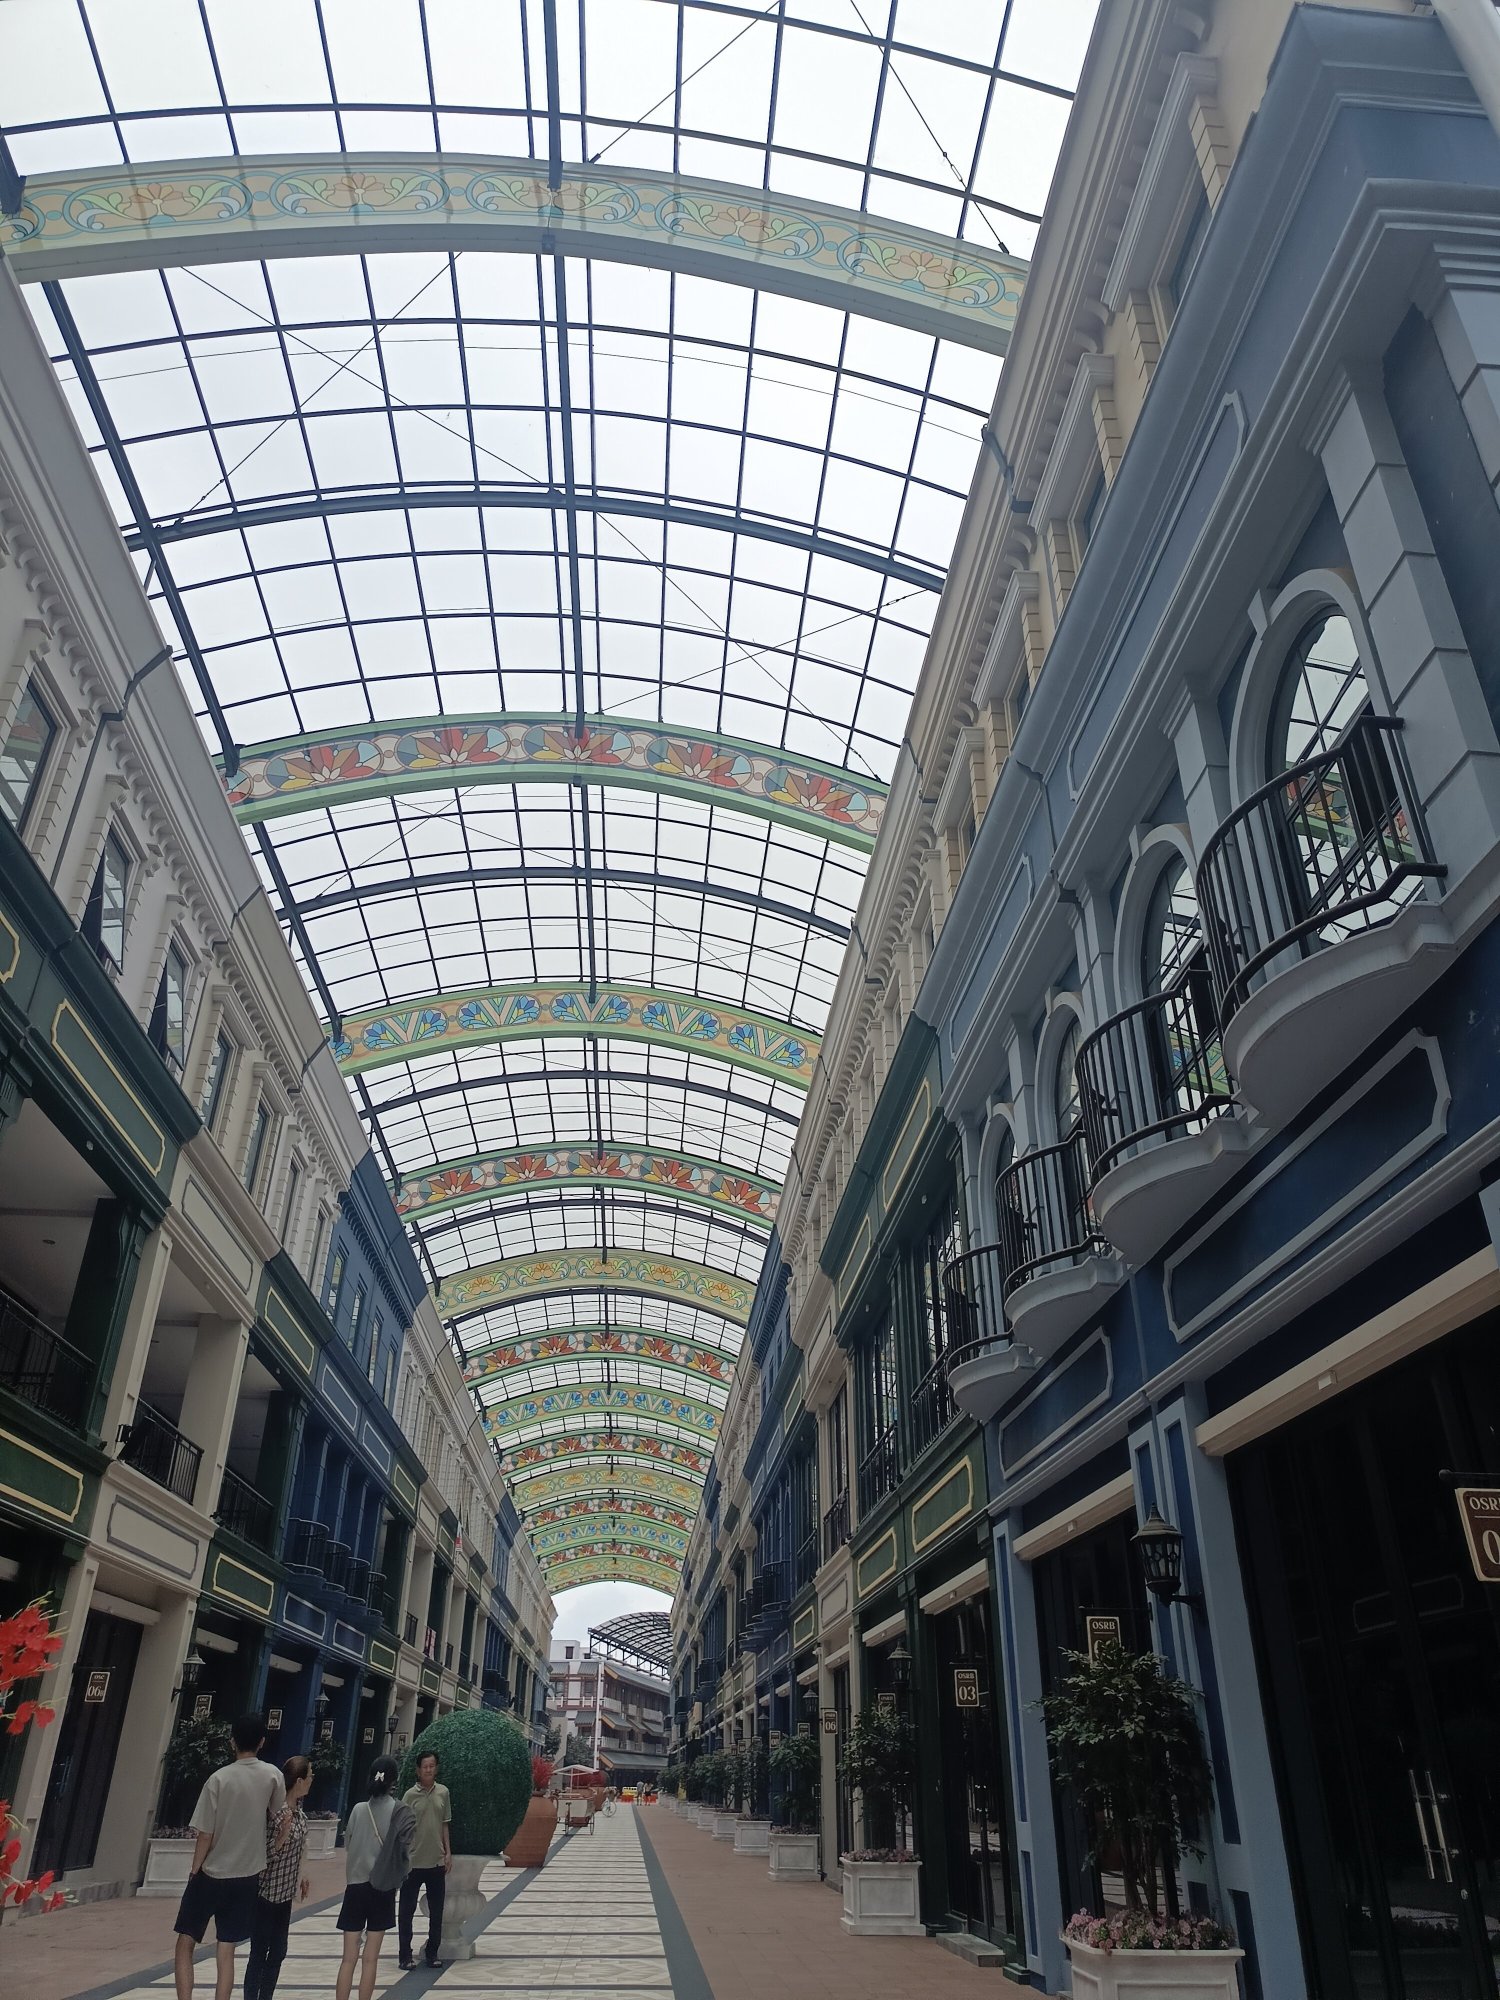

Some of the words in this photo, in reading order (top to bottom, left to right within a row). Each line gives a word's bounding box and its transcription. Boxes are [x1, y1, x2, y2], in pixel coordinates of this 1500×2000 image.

[1469, 1497, 1500, 1510] OSR
[1092, 1621, 1116, 1630] OSRB
[958, 1686, 976, 1700] 03
[825, 1721, 836, 1730] 06
